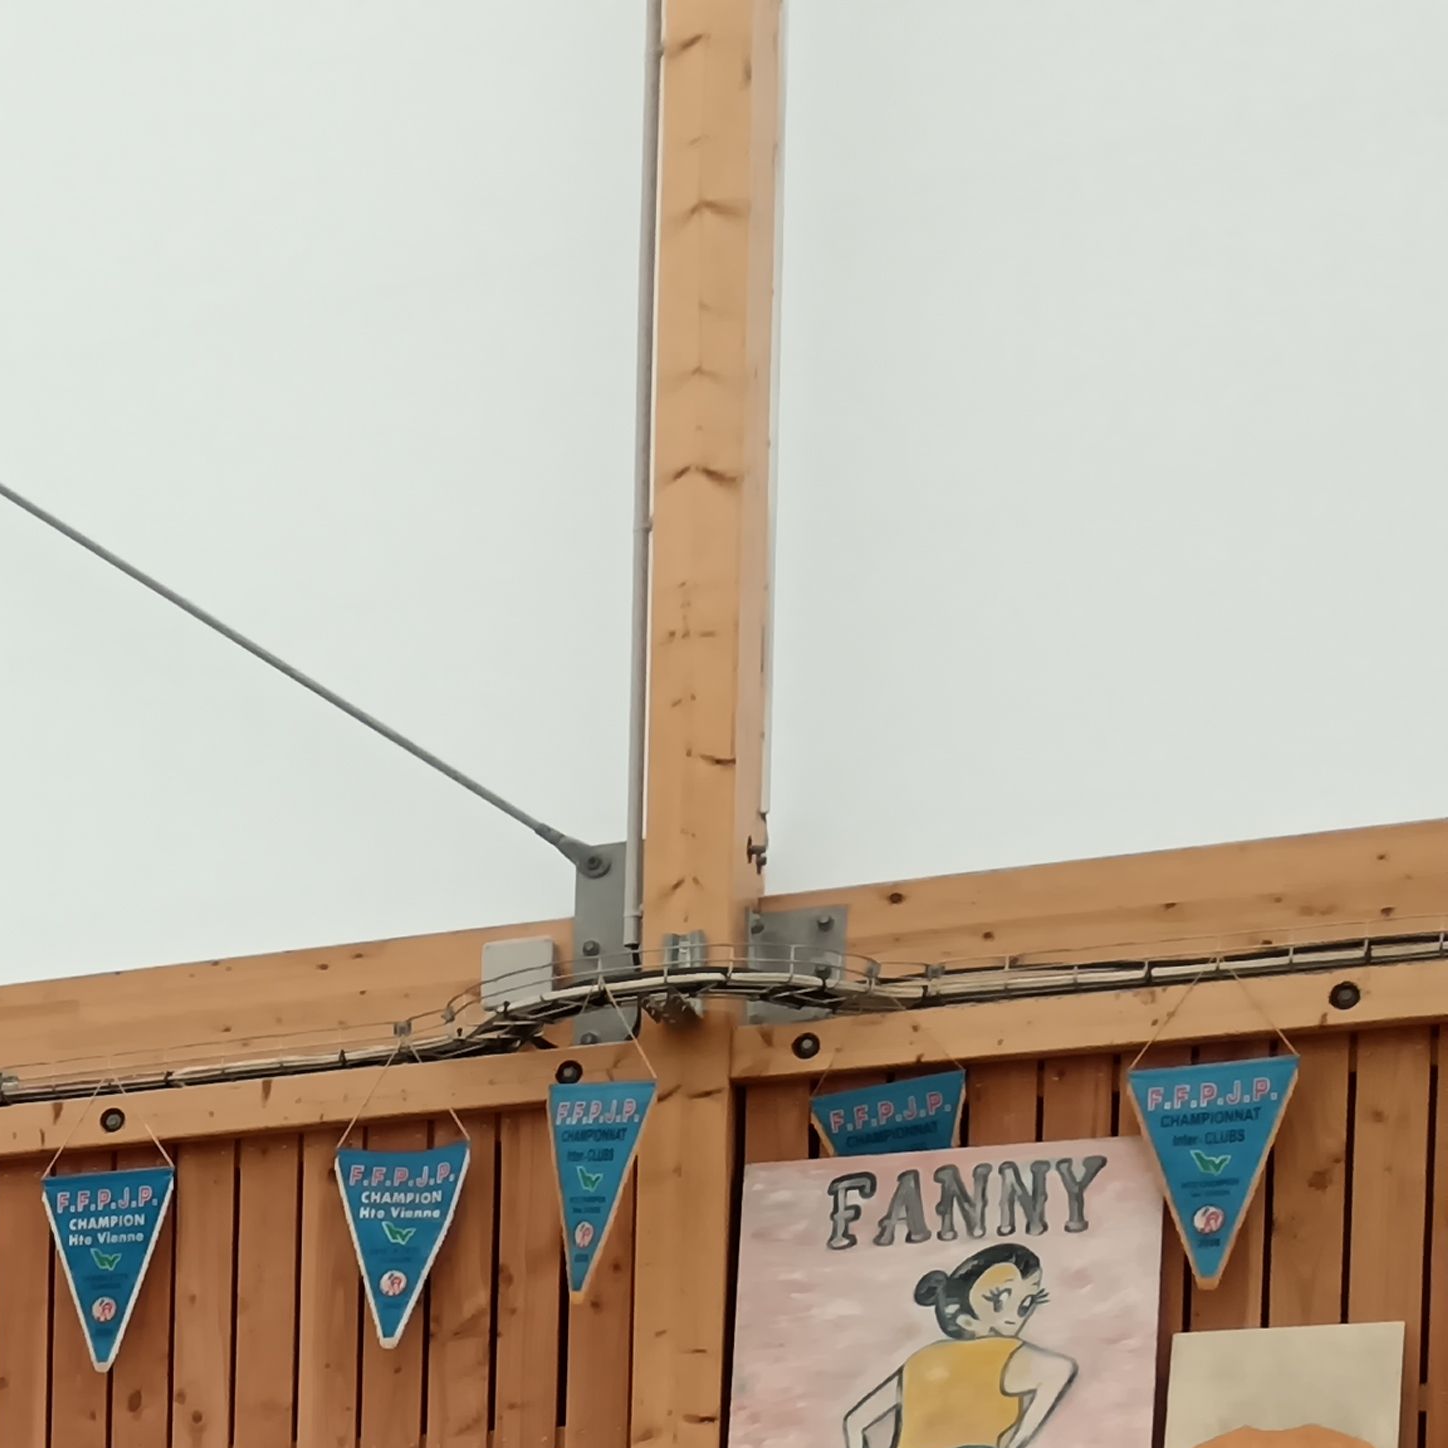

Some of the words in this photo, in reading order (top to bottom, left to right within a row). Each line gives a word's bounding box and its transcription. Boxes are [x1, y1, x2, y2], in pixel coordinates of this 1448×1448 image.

[1148, 1077, 1278, 1111] F.F.P.J.P.
[556, 1098, 640, 1125] F.F.P.J.P.
[829, 1091, 952, 1134] F.F.P.J.P.
[1160, 1107, 1262, 1128] CHAMPIONNAT
[1204, 1129, 1246, 1145] CLUBS
[349, 1162, 455, 1187] F.F.P.J.P.
[57, 1185, 158, 1214] F.F.P.J.P.
[361, 1190, 443, 1205] CHAMPION
[826, 1155, 1108, 1251] FANNY
[68, 1213, 145, 1231] CHAMPION
[359, 1206, 385, 1219] Hte
[390, 1206, 441, 1219] Vienne
[68, 1233, 92, 1247] Hte
[97, 1231, 144, 1244] Vienne
